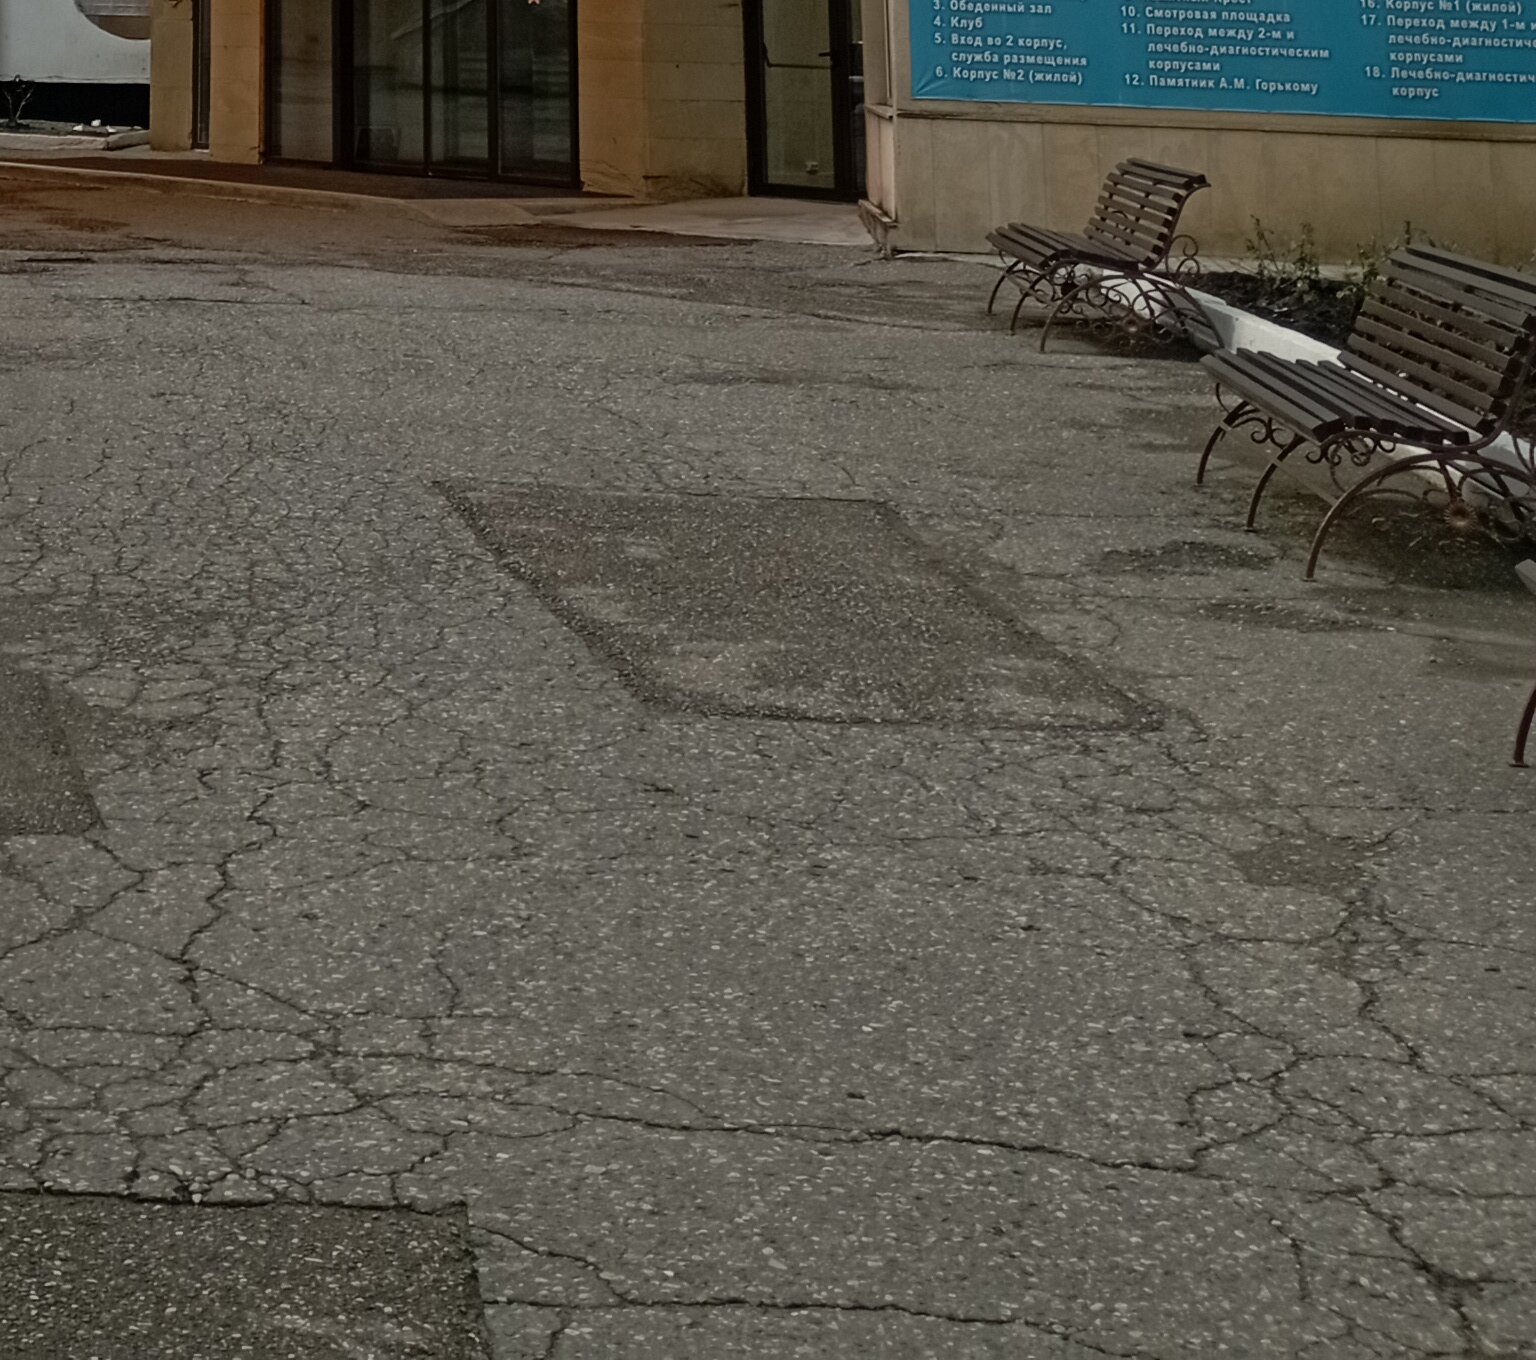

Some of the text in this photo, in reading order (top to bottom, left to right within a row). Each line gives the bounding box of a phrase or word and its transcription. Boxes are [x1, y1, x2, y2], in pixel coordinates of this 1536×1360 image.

[934, 0, 1051, 14] 3. Обеденный зал
[1439, 0, 1460, 11] №1
[1466, 1, 1522, 15] (жилой)
[1121, 6, 1290, 24] 10. Смотровая площадка
[934, 16, 983, 30] 4. Клуб
[1361, 15, 1381, 25] 17.
[1387, 15, 1445, 29] Переход
[1450, 20, 1497, 32] между
[1502, 19, 1525, 30] 1-м
[1121, 23, 1294, 40] 11. Переход между 2-м и
[934, 33, 945, 43] 5.
[951, 34, 982, 46] Вход
[1006, 36, 1013, 45] 2
[952, 51, 1087, 67] служба размещения
[1149, 58, 1221, 72] корпусами
[1390, 52, 1463, 64] корпусами
[936, 67, 1082, 85] 6. Корпус №2 (жилой)
[1365, 67, 1385, 77] 18.
[1124, 74, 1318, 94] 12. Памятник А.М. Горькому
[1393, 87, 1439, 99] корпус
